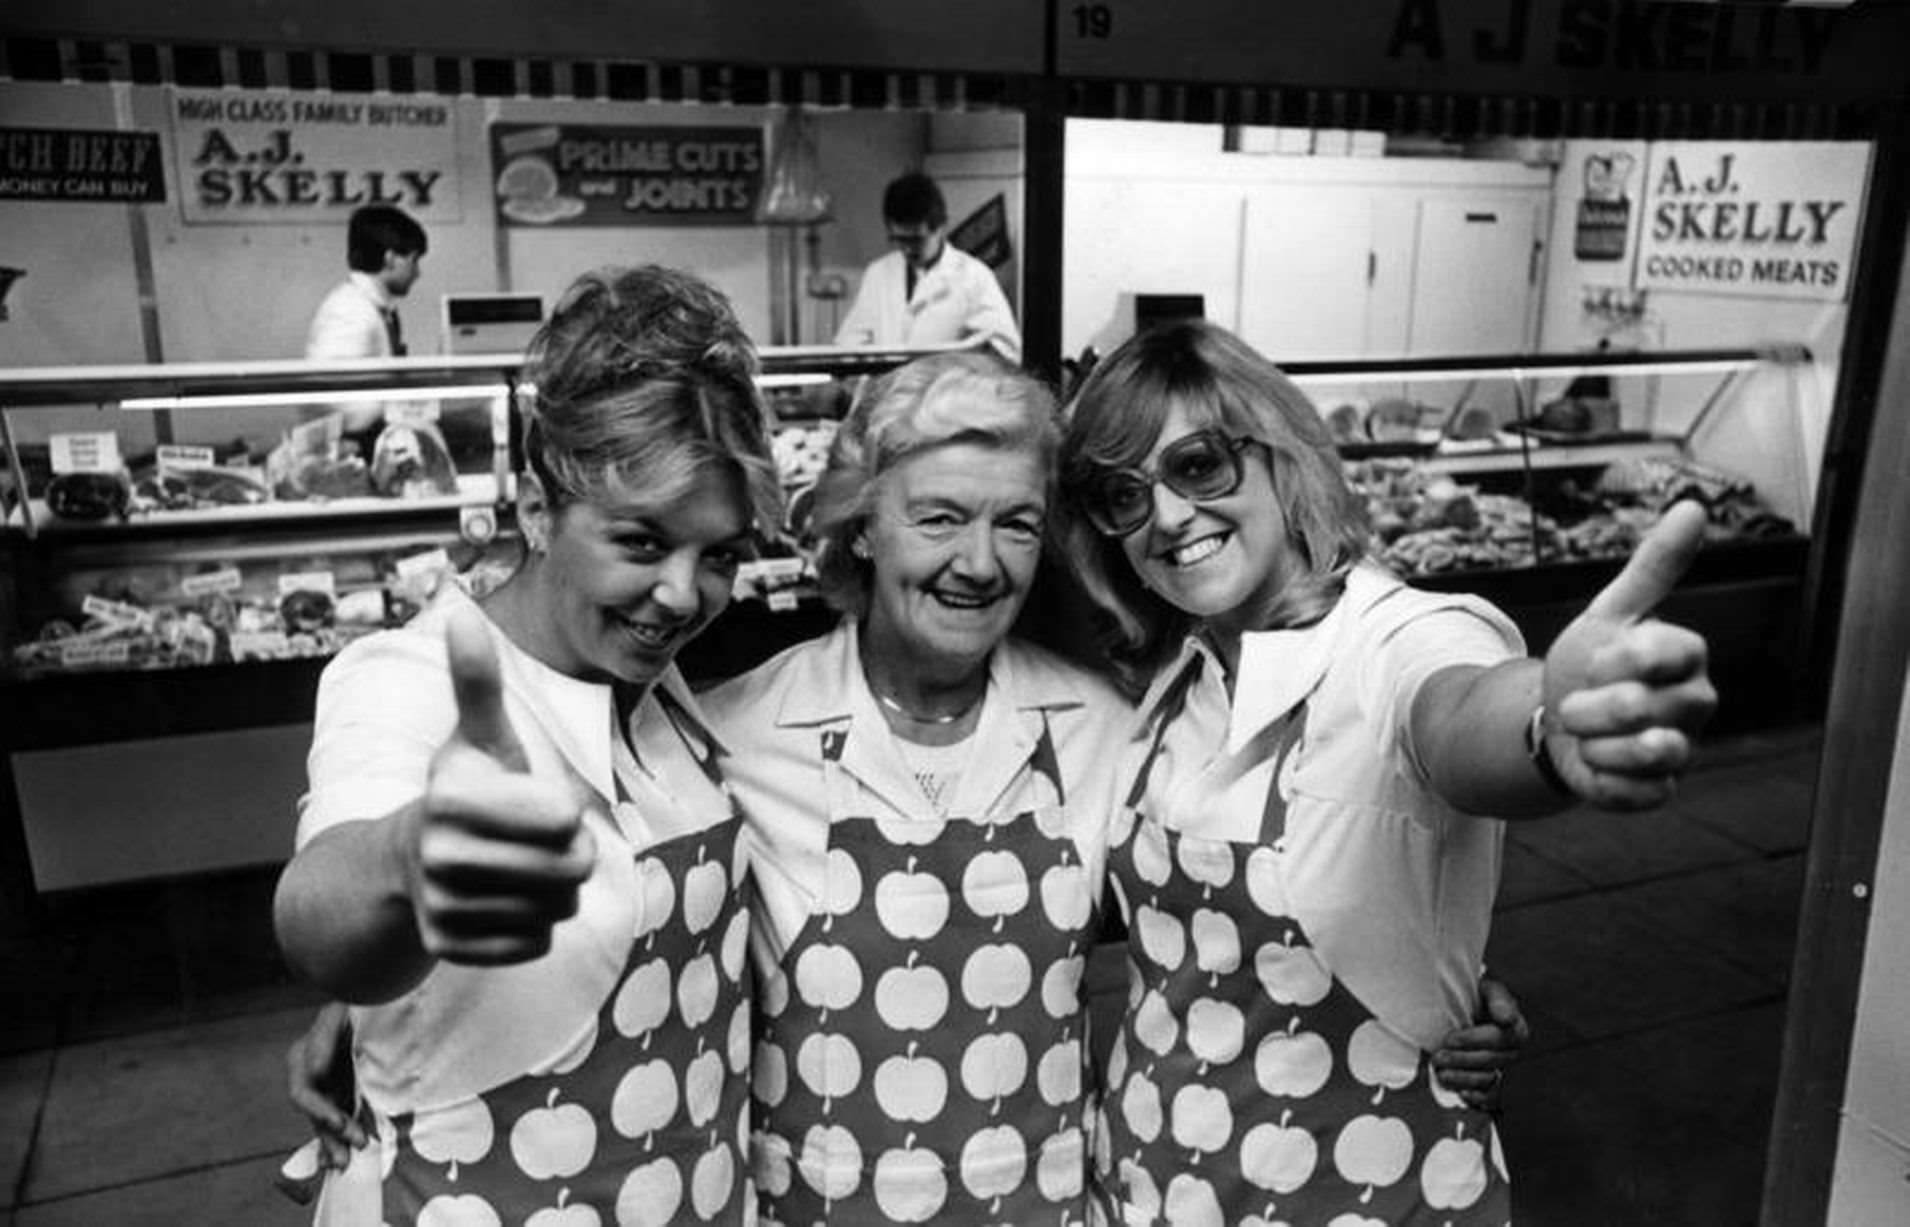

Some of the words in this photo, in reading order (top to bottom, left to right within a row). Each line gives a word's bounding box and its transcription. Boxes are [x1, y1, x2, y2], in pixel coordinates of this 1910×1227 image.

[1073, 6, 1111, 39] 19
[1387, 0, 1445, 61] A
[1472, 0, 1531, 65] J
[1557, 0, 1841, 71] SKELLY
[178, 99, 223, 121] HIGH
[228, 101, 287, 122] CLASS
[293, 102, 362, 124] FAMILY
[368, 106, 447, 125] BUTCHER
[68, 134, 153, 173] BEEF
[196, 129, 304, 164] A.J.
[560, 140, 672, 171] PRIME
[676, 142, 760, 171] CUTS
[65, 178, 105, 195] CAN
[111, 179, 151, 196] BUY
[200, 170, 441, 206] SKELLY
[1657, 153, 1740, 195] A.J.
[579, 180, 617, 197] and
[625, 178, 749, 209] JOINTS
[1653, 201, 1845, 244] SKELLY
[1646, 255, 1744, 280] COOKED
[1752, 258, 1840, 286] MEATS
